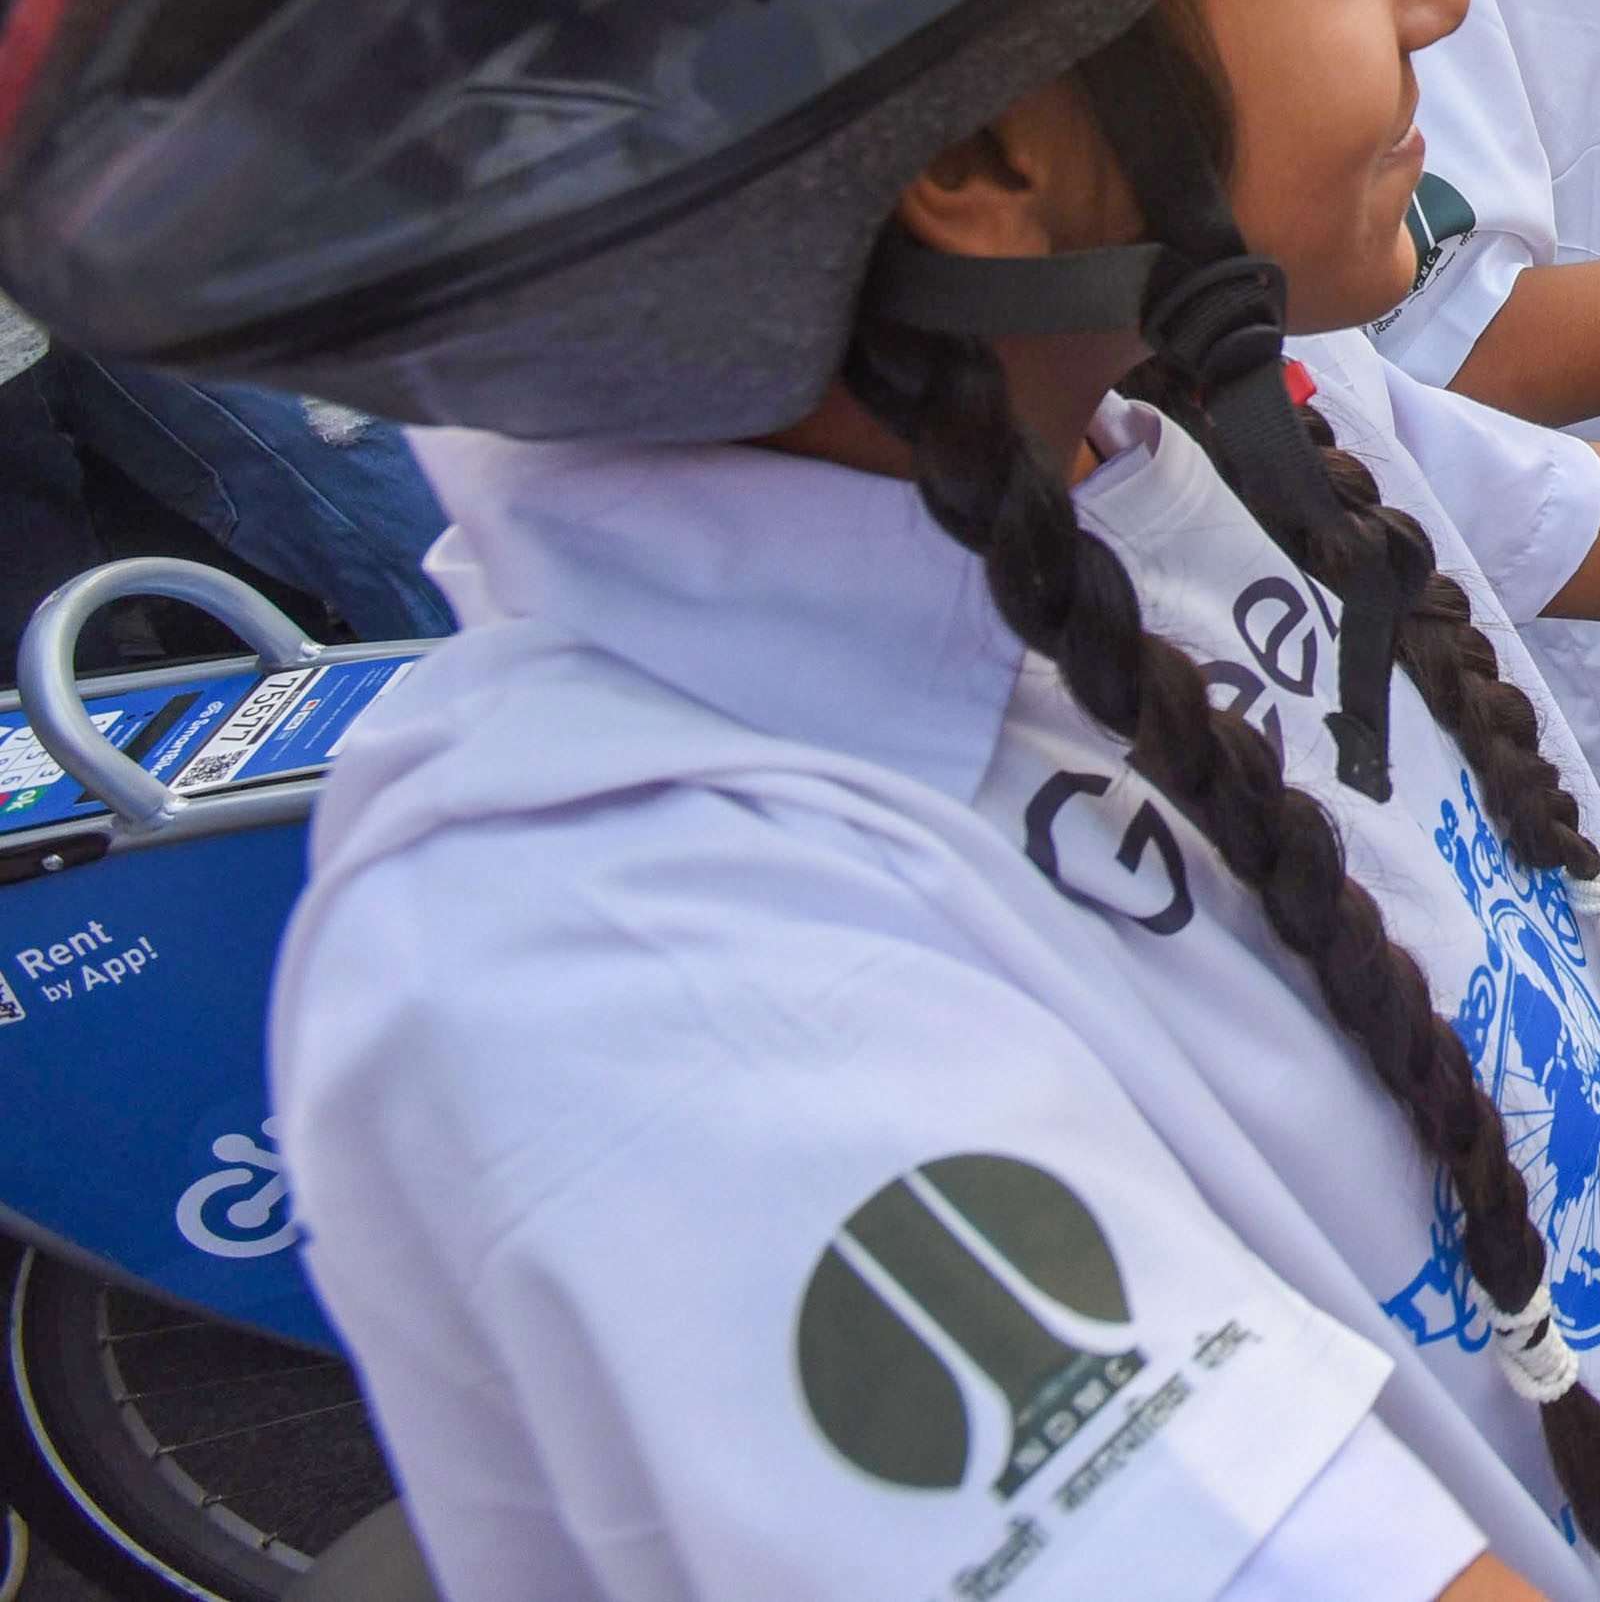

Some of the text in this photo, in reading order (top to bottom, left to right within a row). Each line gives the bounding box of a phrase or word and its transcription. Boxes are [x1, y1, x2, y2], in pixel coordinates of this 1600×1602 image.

[219, 675, 299, 745] 75577
[16, 920, 113, 980] Rent
[41, 936, 159, 1004] by App!
